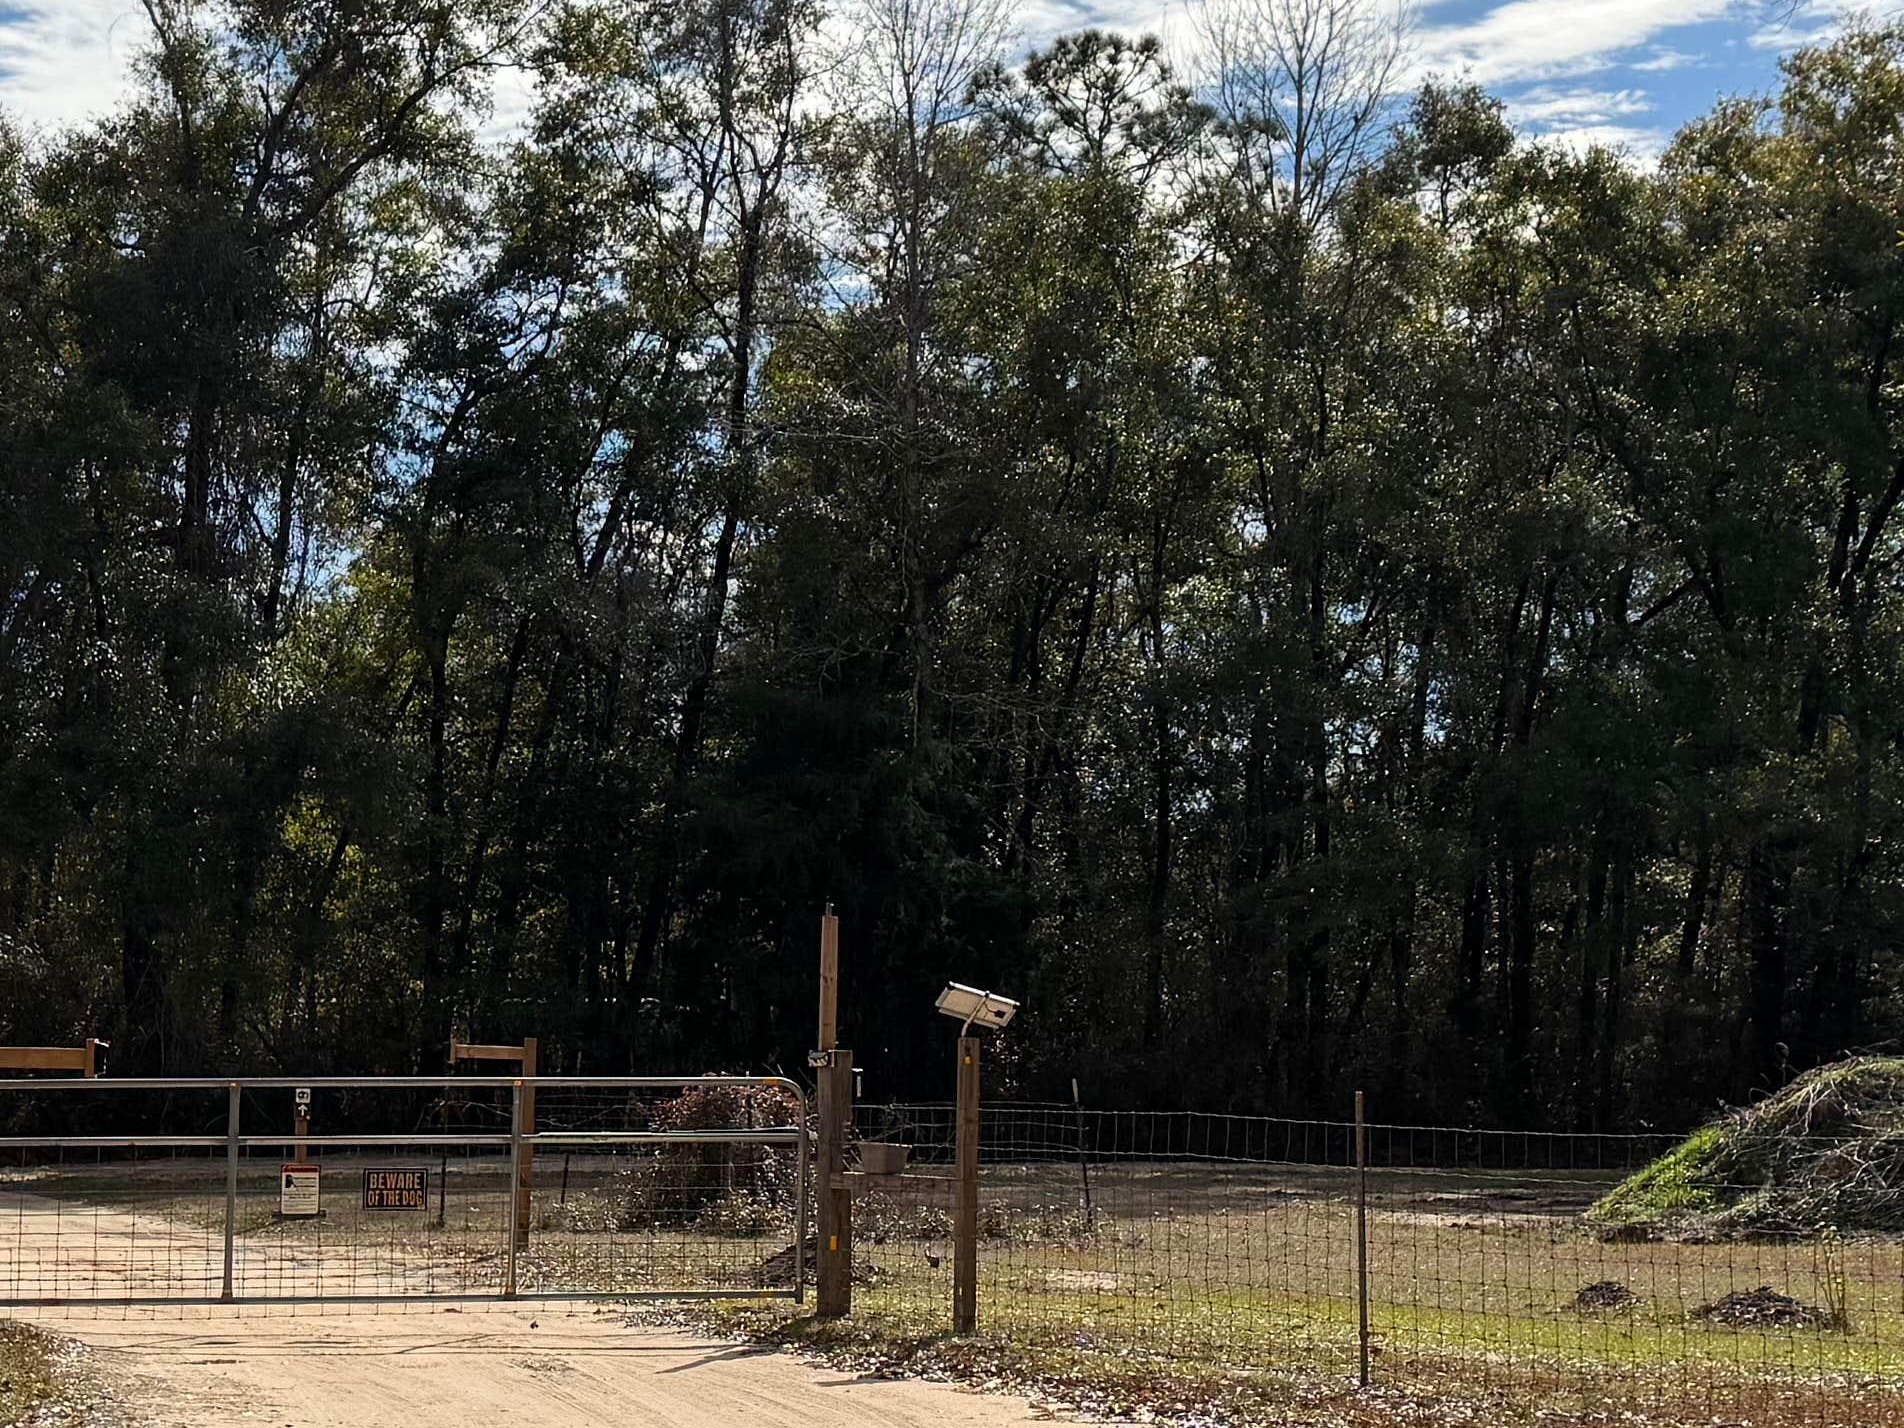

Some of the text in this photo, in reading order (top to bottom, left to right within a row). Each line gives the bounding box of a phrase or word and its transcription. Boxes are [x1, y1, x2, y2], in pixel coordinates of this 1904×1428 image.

[369, 1173, 422, 1189] BEWARE
[368, 1190, 423, 1206] OF THE DOG
